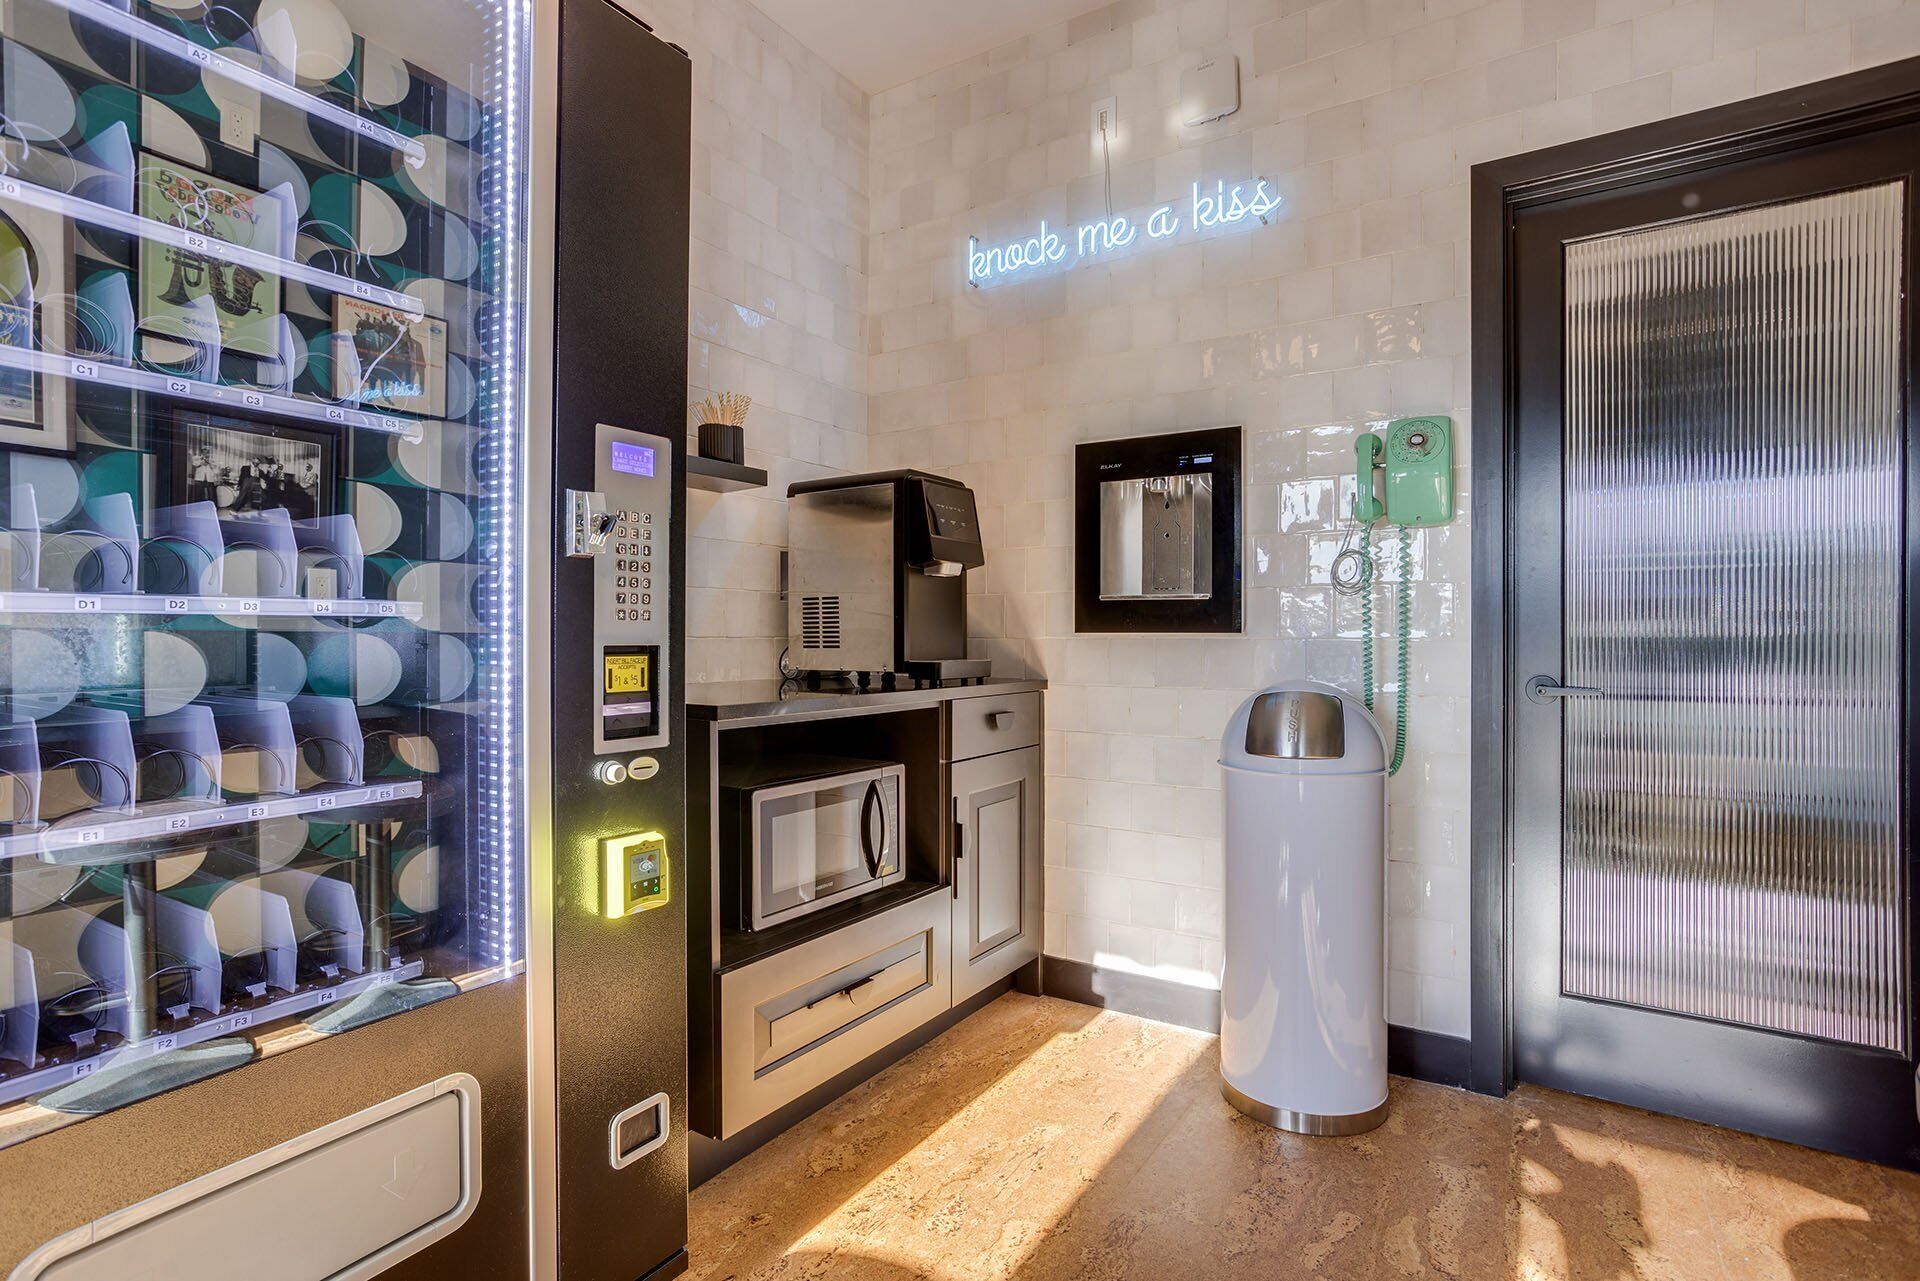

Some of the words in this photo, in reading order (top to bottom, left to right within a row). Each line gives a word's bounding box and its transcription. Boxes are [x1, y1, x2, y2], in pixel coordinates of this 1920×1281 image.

[192, 49, 208, 61] A2
[360, 122, 372, 132] A4
[969, 220, 1066, 280] knock
[1078, 217, 1135, 255] me
[1147, 206, 1179, 238] a
[1193, 179, 1282, 231] kiss
[188, 236, 204, 249] B2
[356, 285, 368, 295] B4
[76, 364, 94, 376] C1
[171, 381, 187, 393] C2
[246, 394, 260, 405] C3
[329, 410, 341, 419] C4
[385, 419, 397, 428] C5
[78, 600, 96, 610] D1
[169, 600, 185, 609] D2
[243, 602, 258, 611] D3
[316, 603, 330, 612] D4
[381, 605, 394, 613] D5
[1287, 699, 1300, 743] PUSH
[379, 789, 391, 799] E5
[320, 797, 333, 807] E4
[251, 806, 265, 817] E3
[171, 818, 187, 829] E2
[82, 831, 99, 841] E1
[320, 991, 333, 1001] F4
[234, 1016, 248, 1027] F3
[158, 1038, 173, 1049] F2
[76, 1063, 93, 1075] F1
